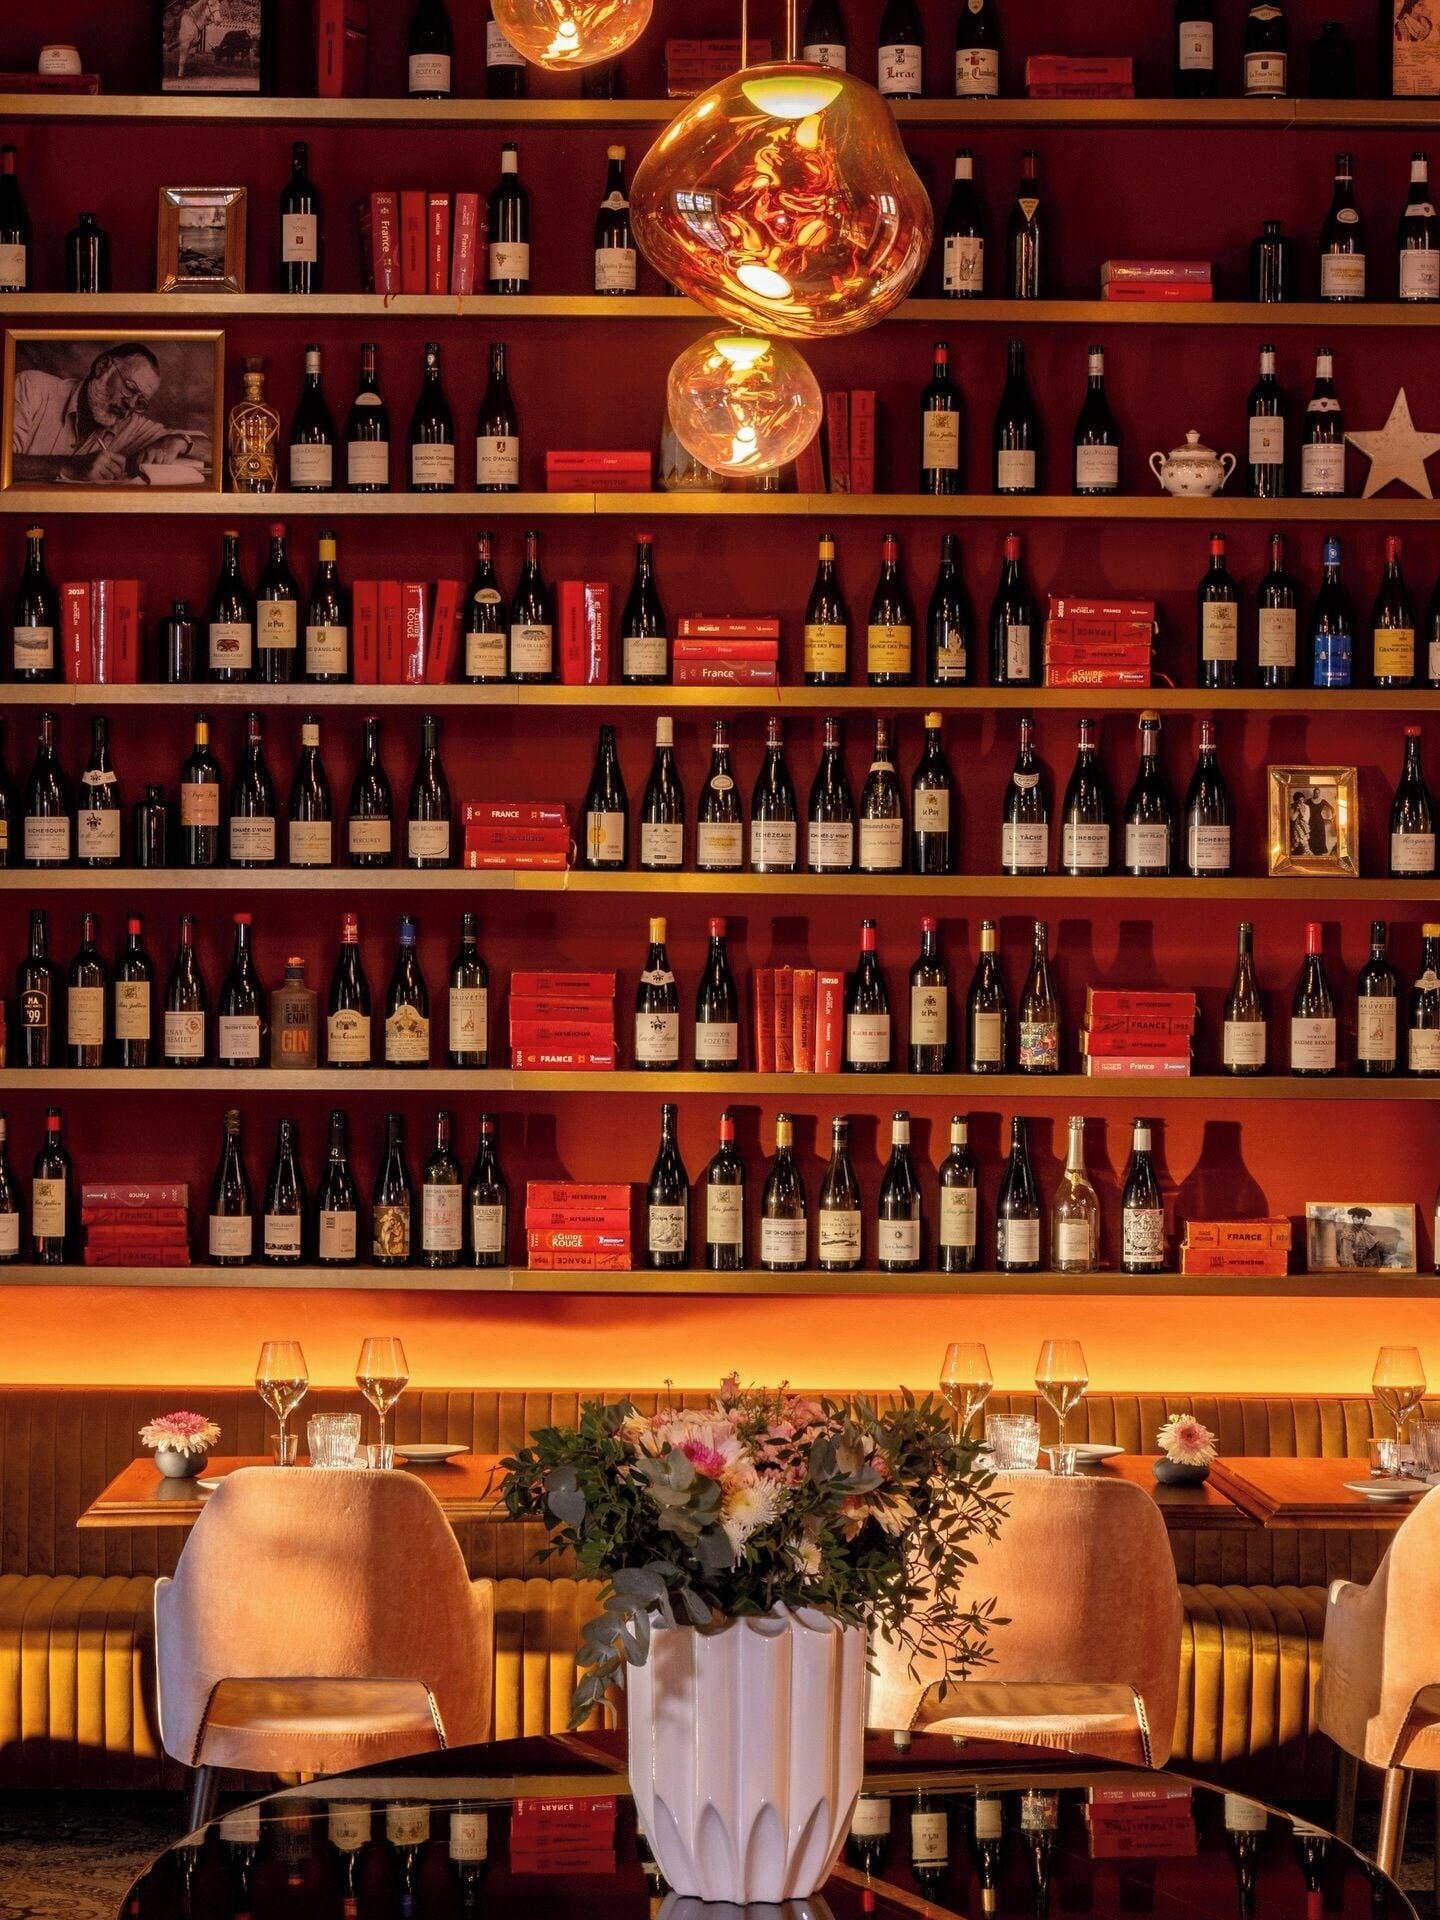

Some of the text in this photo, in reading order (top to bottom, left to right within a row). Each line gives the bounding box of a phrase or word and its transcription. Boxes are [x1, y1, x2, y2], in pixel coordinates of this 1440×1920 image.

[886, 67, 915, 79] Lirac
[381, 221, 390, 253] France
[1149, 267, 1174, 275] France
[1057, 600, 1065, 618] 2019
[407, 607, 415, 639] ROUGE
[702, 668, 734, 678] France
[1072, 675, 1103, 683] ROUGE
[780, 999, 788, 1034] FRANCE
[1131, 1021, 1166, 1029] FRANCE
[281, 1030, 309, 1053] GIN
[540, 1055, 573, 1063] FRANCE
[1227, 1233, 1262, 1241] FRANCE
[552, 1239, 583, 1247] ROUGE
[557, 1257, 592, 1265] FRANCE
